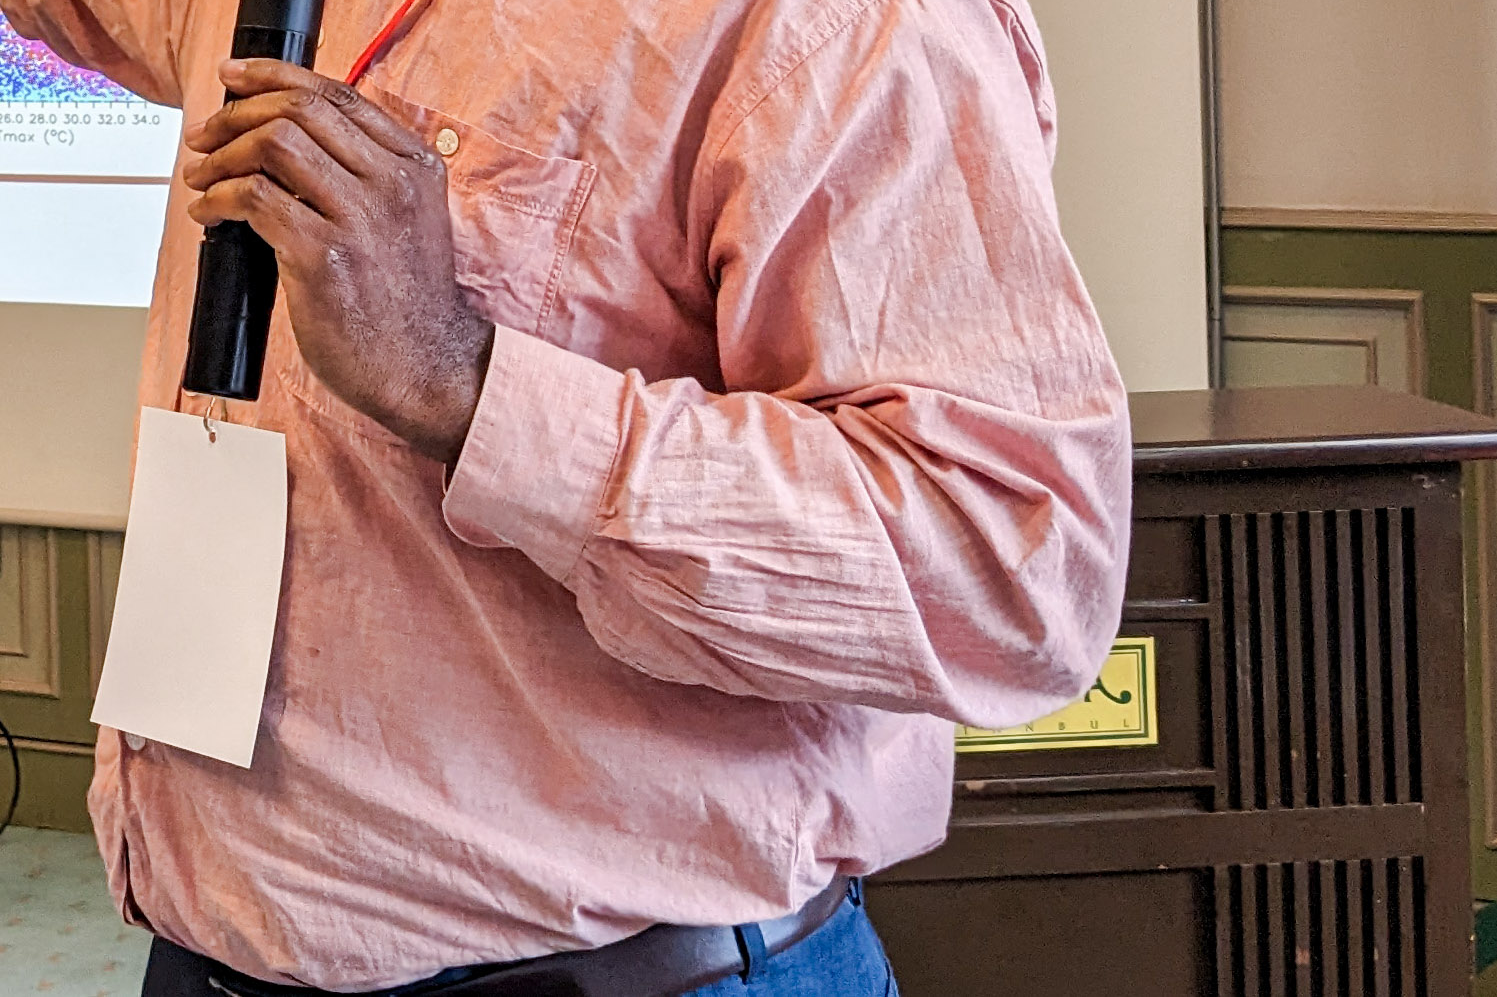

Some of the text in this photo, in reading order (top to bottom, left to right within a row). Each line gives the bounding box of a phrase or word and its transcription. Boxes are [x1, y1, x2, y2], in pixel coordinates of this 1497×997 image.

[29, 113, 57, 124] 28.0
[63, 113, 91, 124] 30.0
[97, 113, 125, 124] 32.0
[132, 113, 160, 125] 34.0
